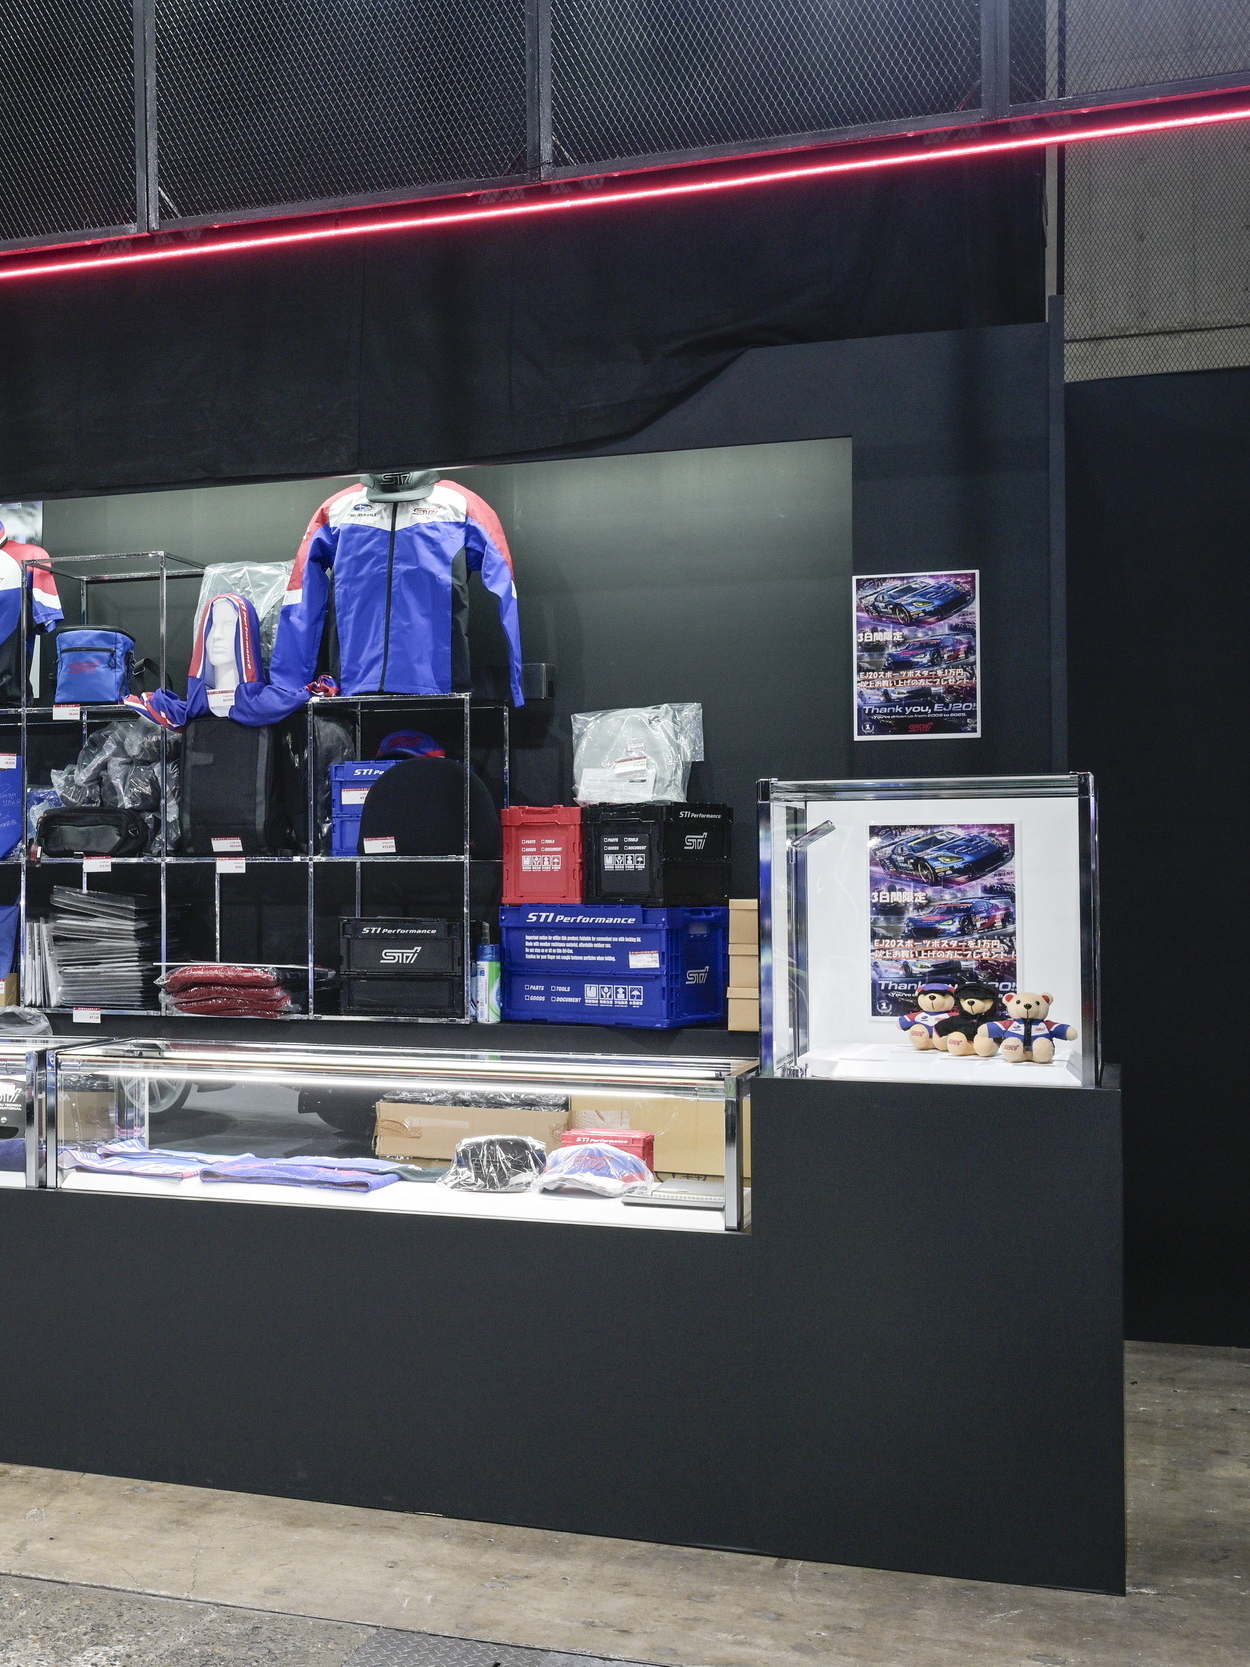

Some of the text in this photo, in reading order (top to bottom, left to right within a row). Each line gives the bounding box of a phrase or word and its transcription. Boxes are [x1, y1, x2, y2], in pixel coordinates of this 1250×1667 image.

[858, 631, 903, 642] 3日間限定
[862, 705, 903, 714] Thank
[905, 706, 932, 715] you,
[353, 768, 372, 776] STI
[679, 810, 691, 818] STI
[871, 891, 927, 903] 3日間限定
[526, 912, 636, 924] STI Performance
